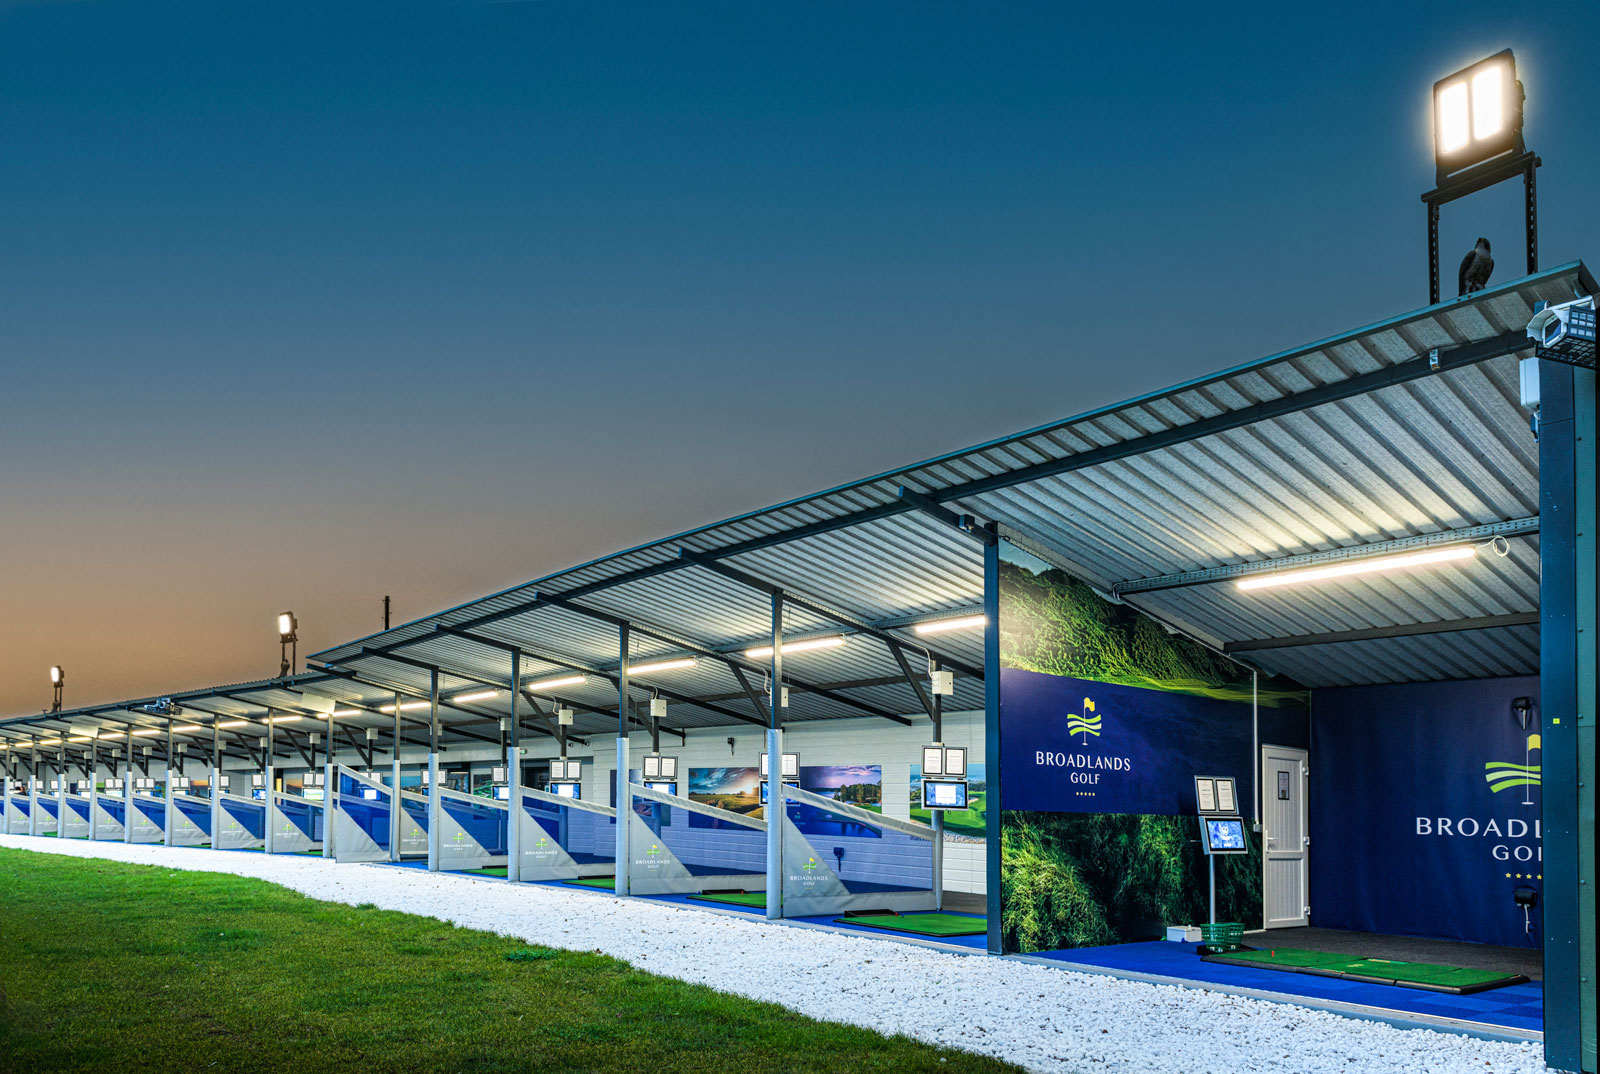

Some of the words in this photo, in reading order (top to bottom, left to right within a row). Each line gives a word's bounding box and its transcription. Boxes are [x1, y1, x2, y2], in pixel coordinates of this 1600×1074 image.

[1036, 751, 1131, 771] BROADLANDS
[1070, 772, 1100, 784] GOLF
[1492, 845, 1542, 861] GO
